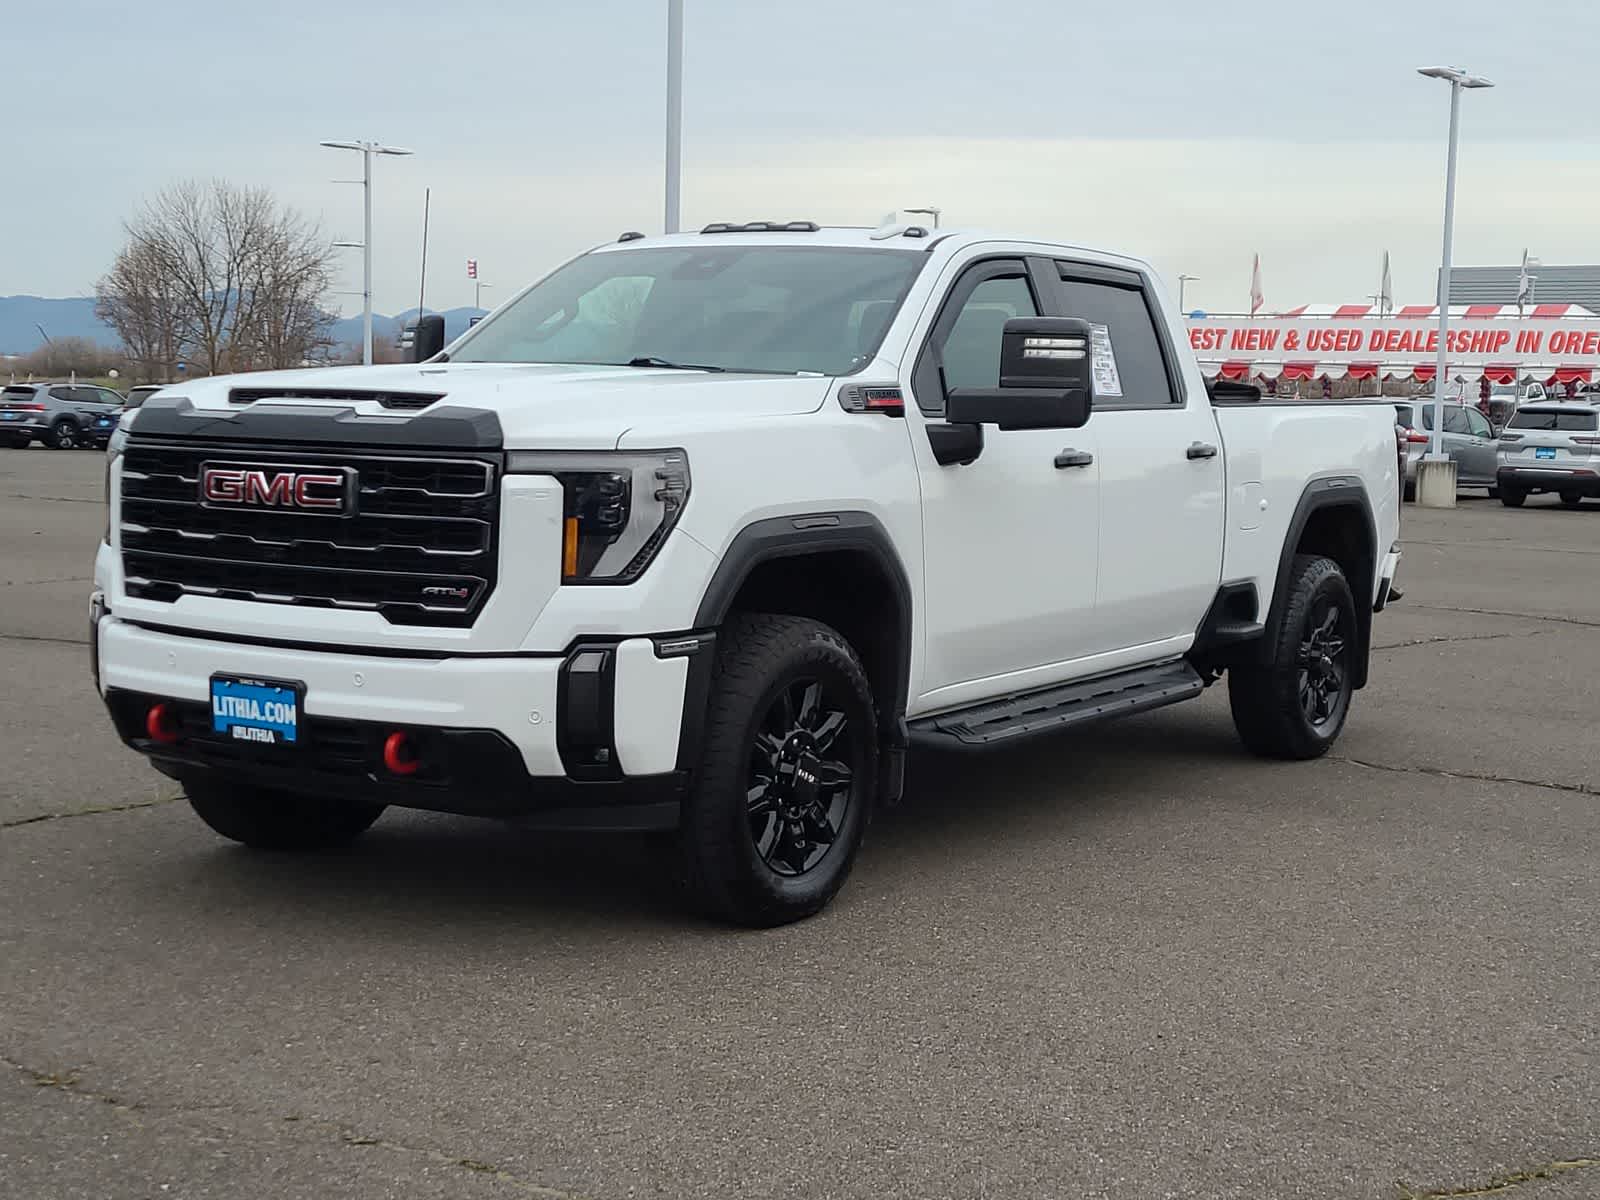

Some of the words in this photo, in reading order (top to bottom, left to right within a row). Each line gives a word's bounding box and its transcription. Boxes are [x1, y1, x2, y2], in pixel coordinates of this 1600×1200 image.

[1187, 328, 1228, 350] EST
[1231, 328, 1280, 350] NEW
[1283, 329, 1300, 351] &
[1306, 329, 1364, 352] USED
[1515, 330, 1543, 353] IN
[1548, 330, 1600, 355] ORE
[204, 469, 343, 509] GMC
[213, 695, 296, 726] LITHIA.COM
